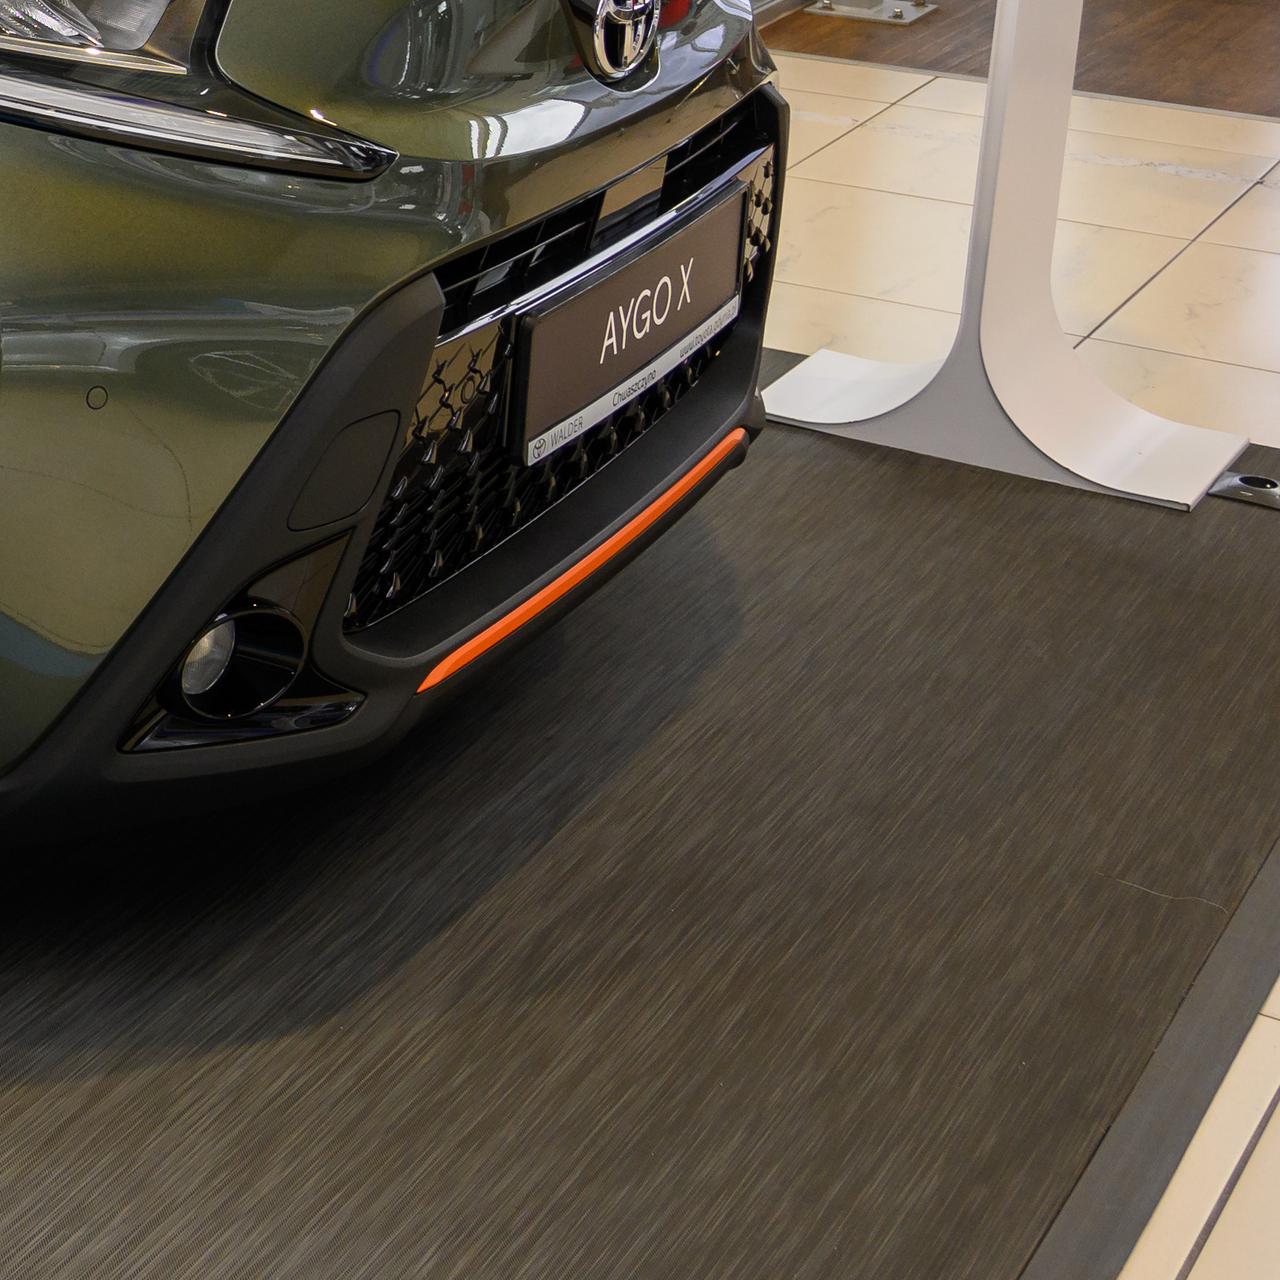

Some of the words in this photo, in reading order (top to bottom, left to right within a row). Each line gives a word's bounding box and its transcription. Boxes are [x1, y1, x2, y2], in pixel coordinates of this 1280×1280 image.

[599, 275, 672, 365] AYGO
[676, 257, 694, 312] X
[612, 370, 657, 407] Chwaszczyno
[550, 416, 584, 448] WALDER
